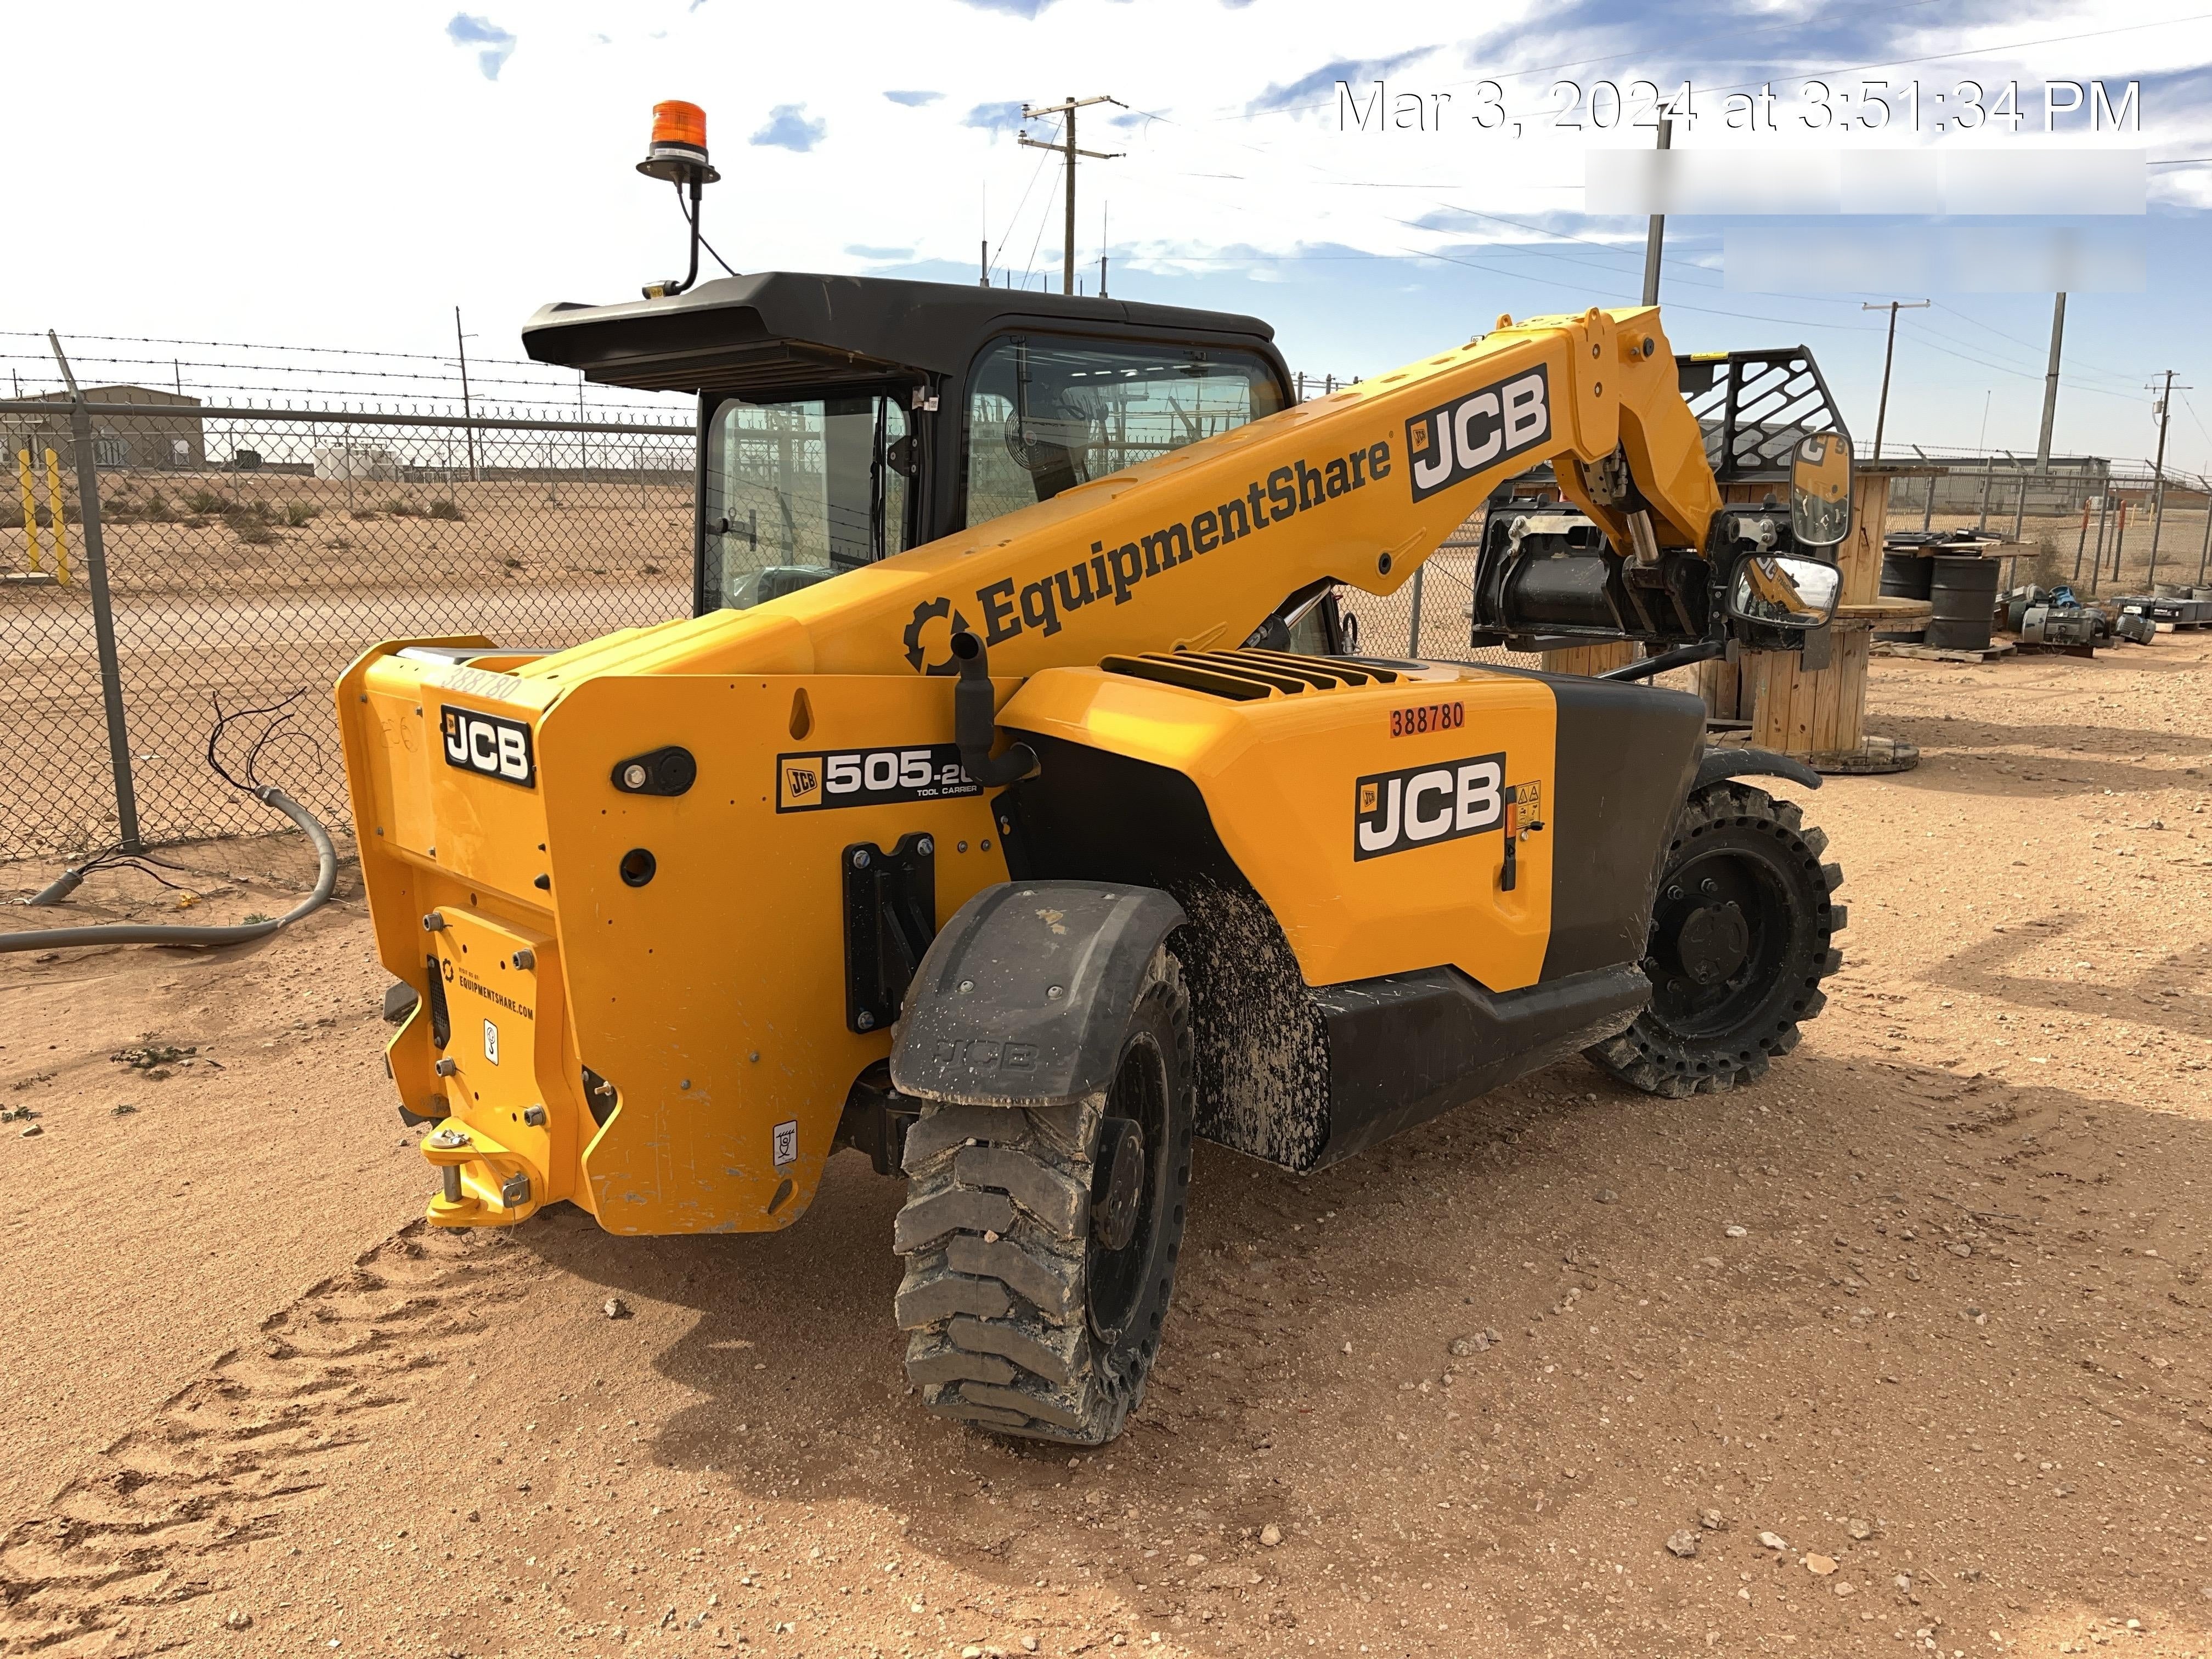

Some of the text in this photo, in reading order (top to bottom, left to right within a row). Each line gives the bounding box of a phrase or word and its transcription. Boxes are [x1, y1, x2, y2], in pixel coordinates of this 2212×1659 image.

[1414, 374, 1548, 489] JCB
[975, 441, 1391, 648] EquipmentShare
[440, 667, 522, 700] 388780
[1392, 702, 1464, 737] 388780
[447, 715, 529, 781] JCB
[792, 771, 815, 794] JCB
[942, 785, 977, 794] CARRIER
[1359, 761, 1501, 851] JCB
[459, 975, 533, 1020] EQUIPMENTSHARE.COM
[933, 1040, 1040, 1073] JCB
